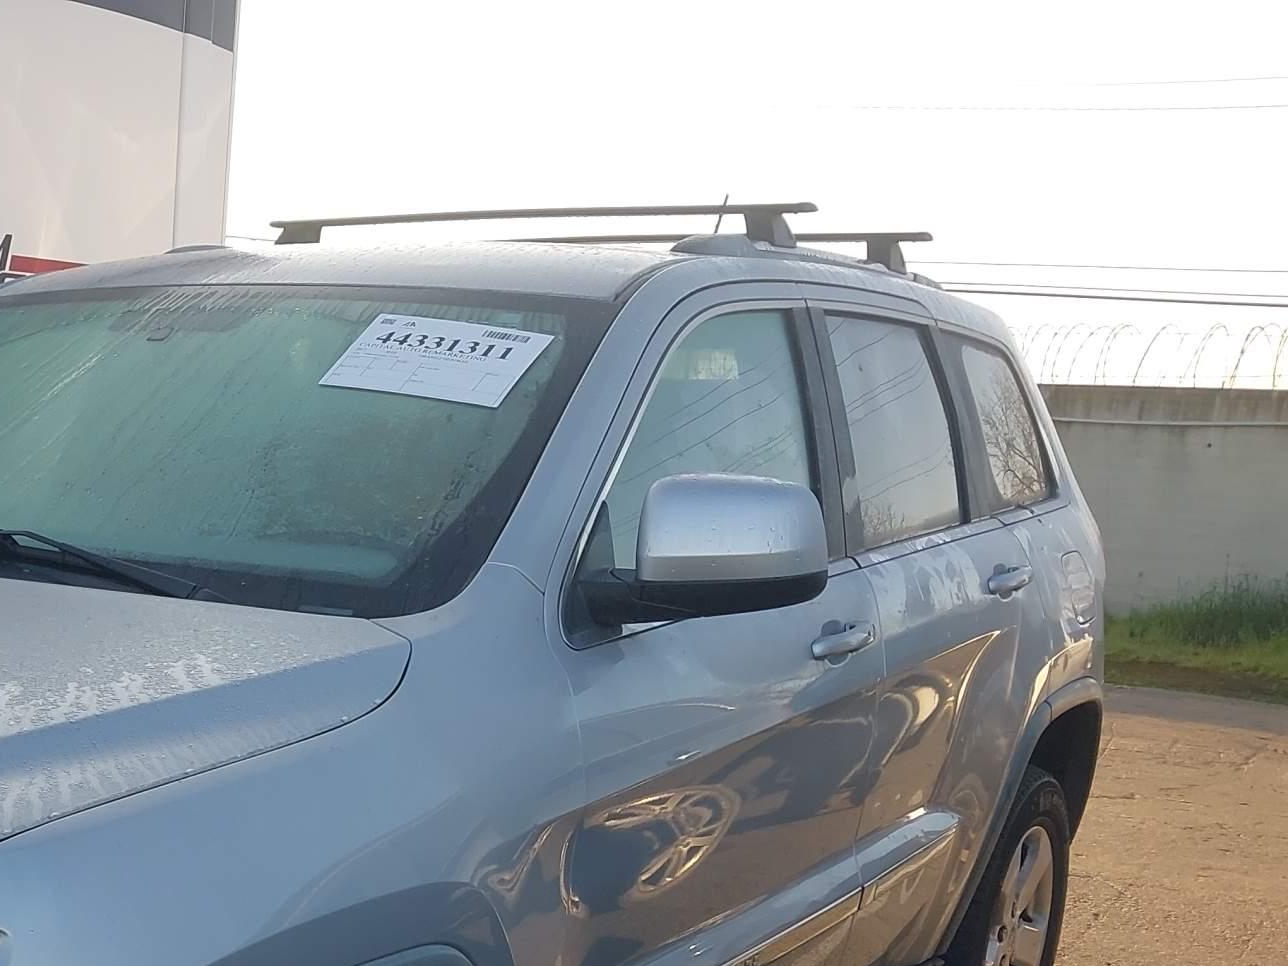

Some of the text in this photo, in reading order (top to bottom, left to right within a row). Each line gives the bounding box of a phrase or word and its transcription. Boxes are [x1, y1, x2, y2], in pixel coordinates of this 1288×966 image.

[359, 342, 395, 351] CAPITAL
[399, 346, 422, 354] AUTO
[422, 348, 487, 362] REMARKETING
[375, 331, 514, 361] 44331311
